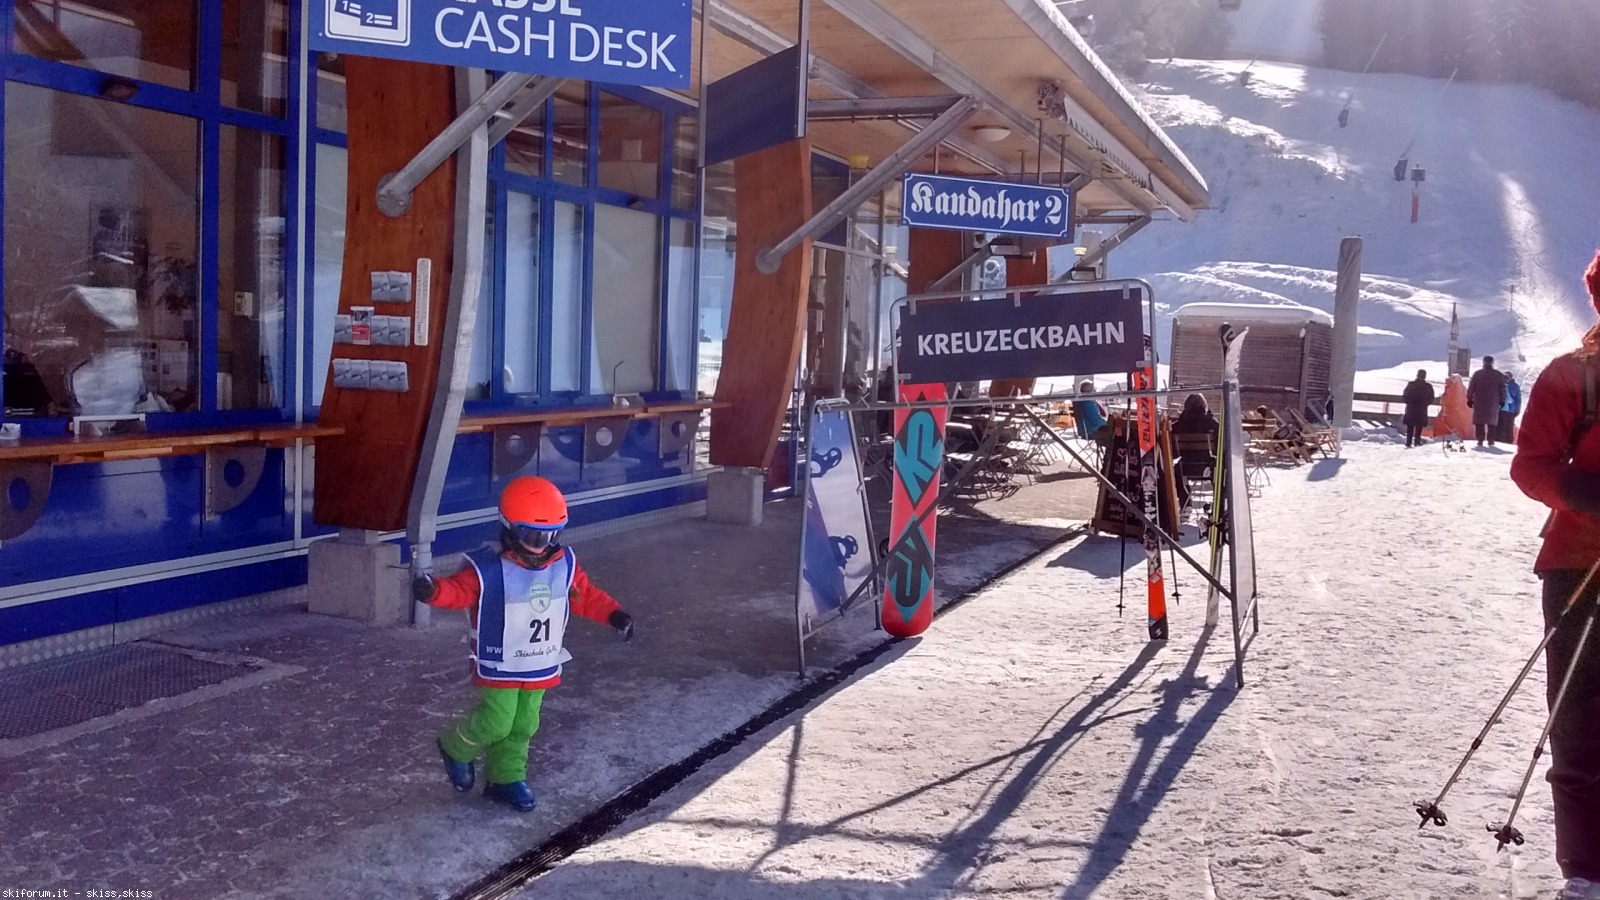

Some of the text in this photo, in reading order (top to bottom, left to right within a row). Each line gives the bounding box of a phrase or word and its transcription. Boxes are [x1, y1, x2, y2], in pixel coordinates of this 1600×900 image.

[434, 7, 677, 72] CASH DESK
[911, 181, 1063, 228] Kandahar 2
[918, 321, 1125, 356] KREUZECKBAHN
[529, 618, 551, 644] 21
